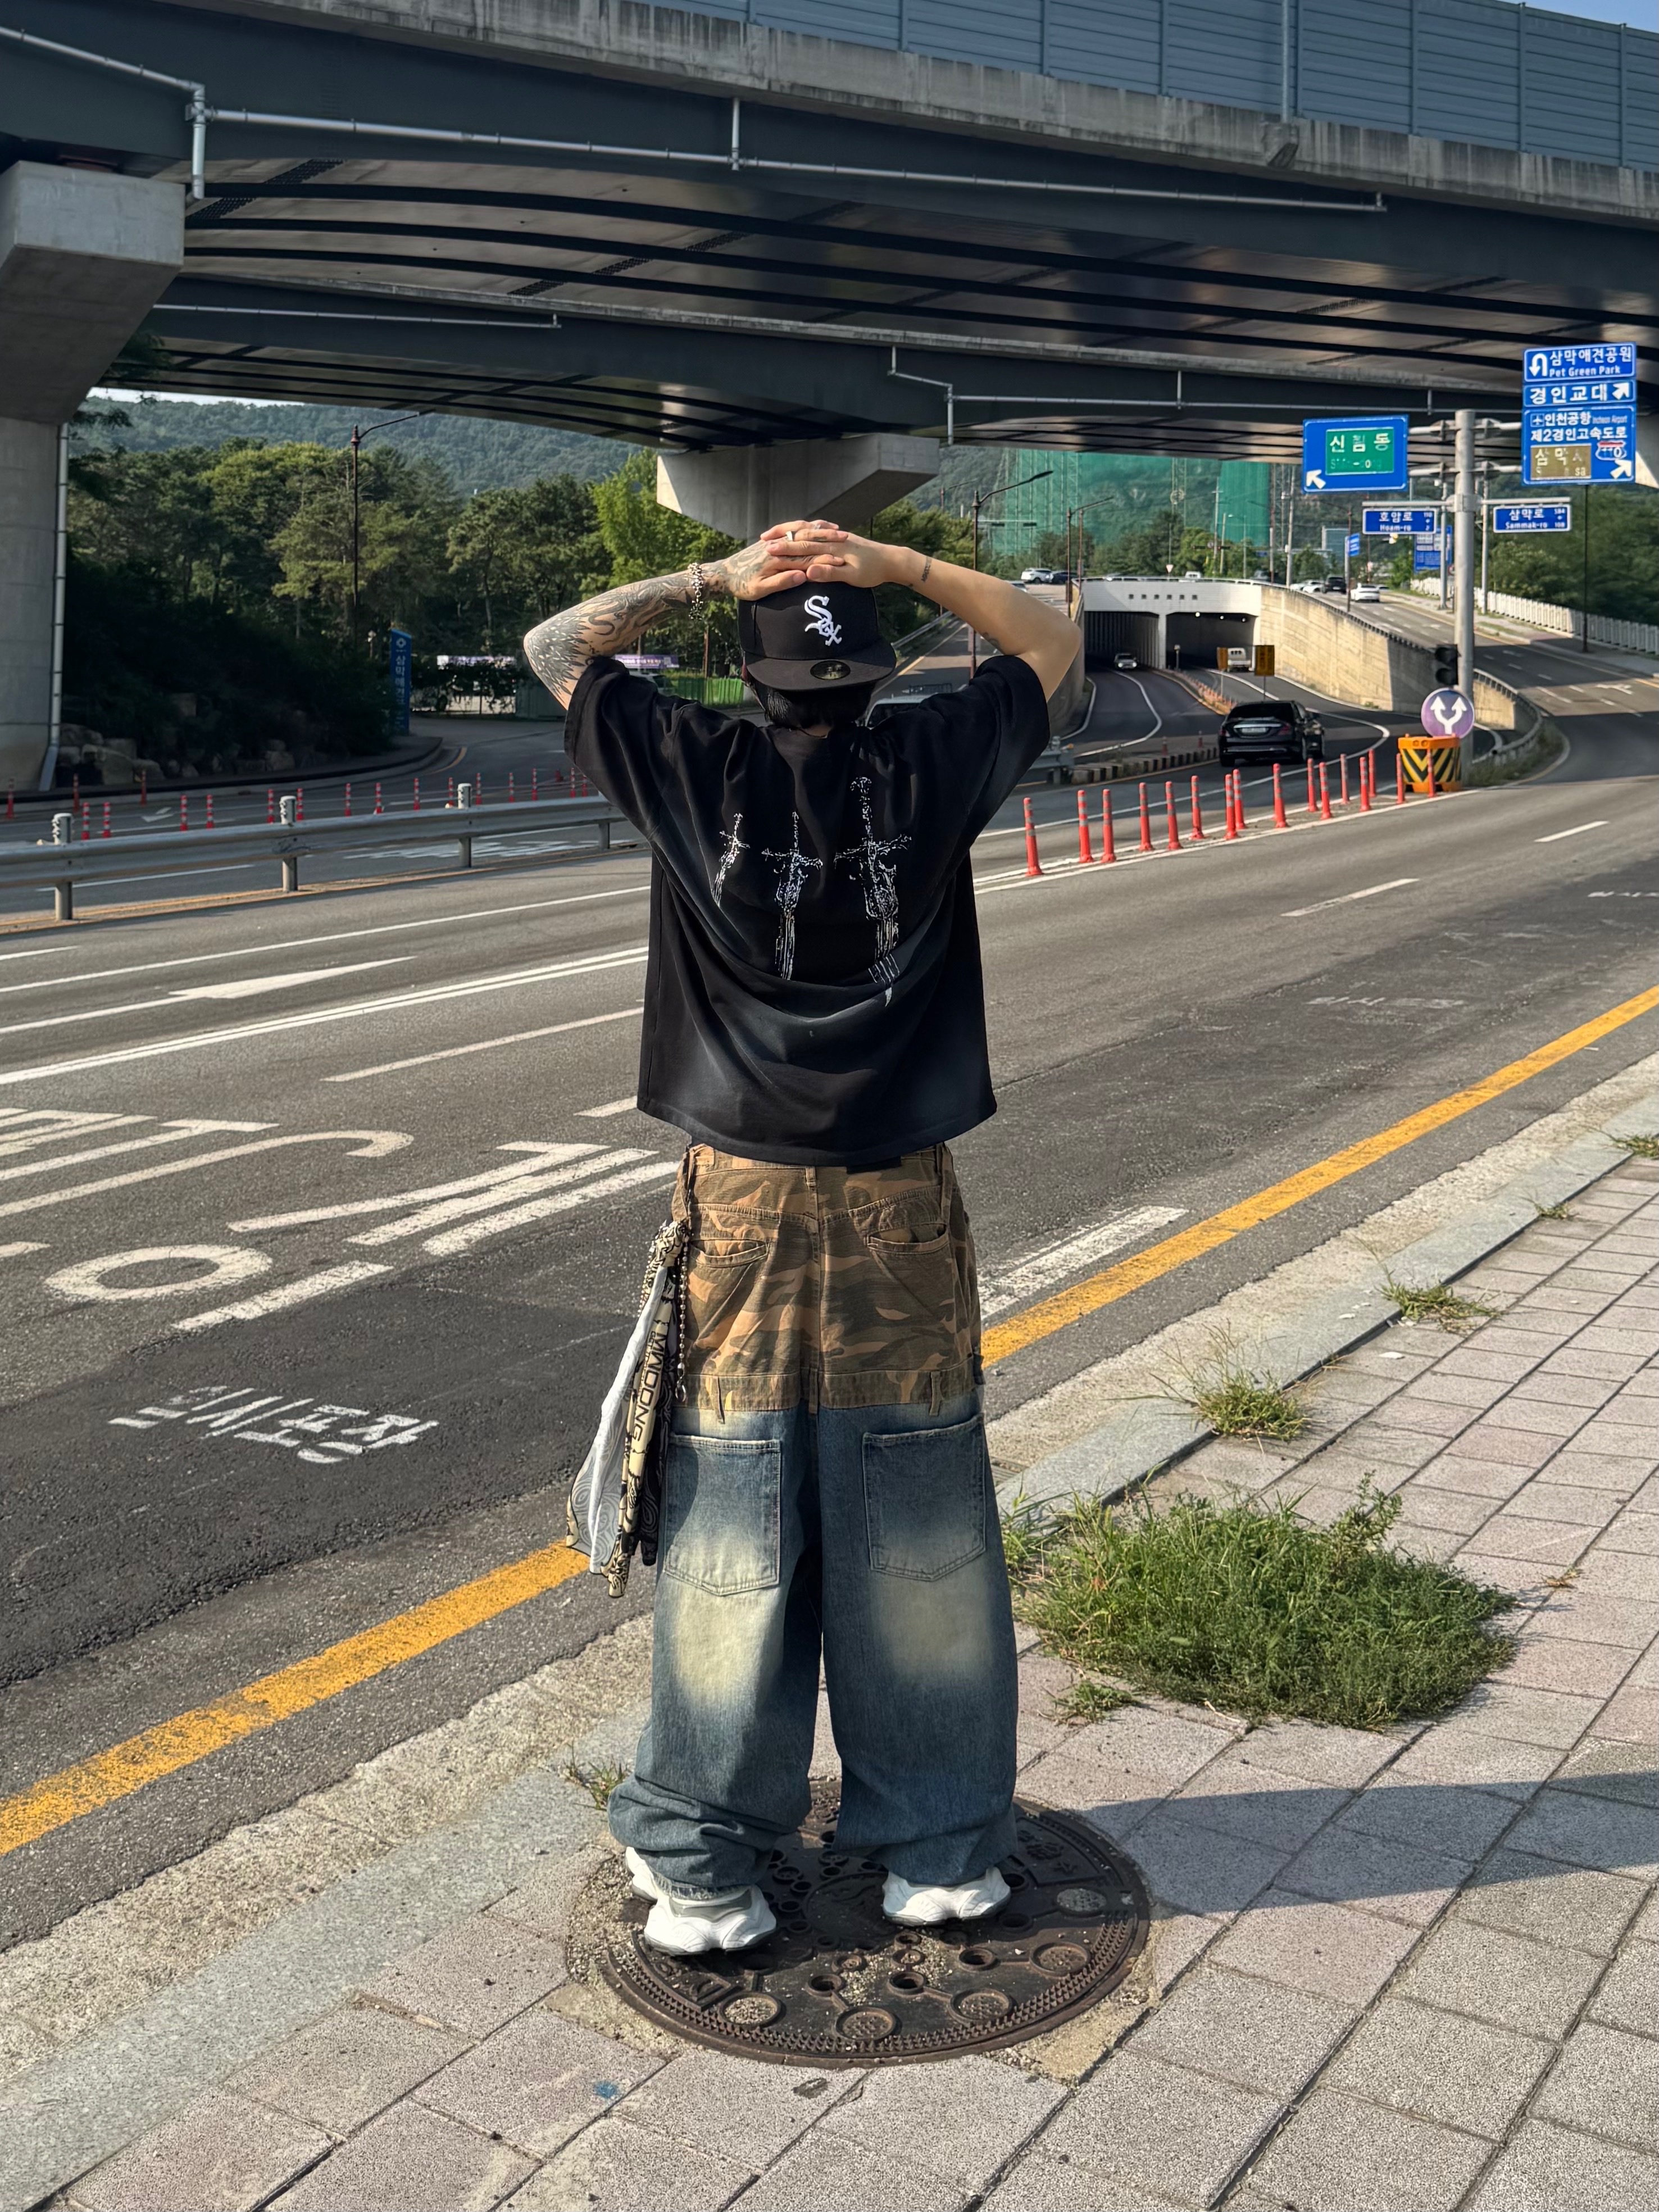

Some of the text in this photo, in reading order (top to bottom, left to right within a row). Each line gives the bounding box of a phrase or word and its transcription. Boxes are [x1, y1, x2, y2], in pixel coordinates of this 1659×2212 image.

[1549, 346, 1631, 366] 삼막애견공원
[1549, 365, 1621, 378] Pet Green Park
[1530, 383, 1607, 405] 경인교대
[1545, 411, 1592, 426] 인천공항
[1530, 426, 1628, 442] 제2경인고속도로
[1379, 512, 1413, 523] 호암로
[1508, 508, 1545, 521] 삼막로
